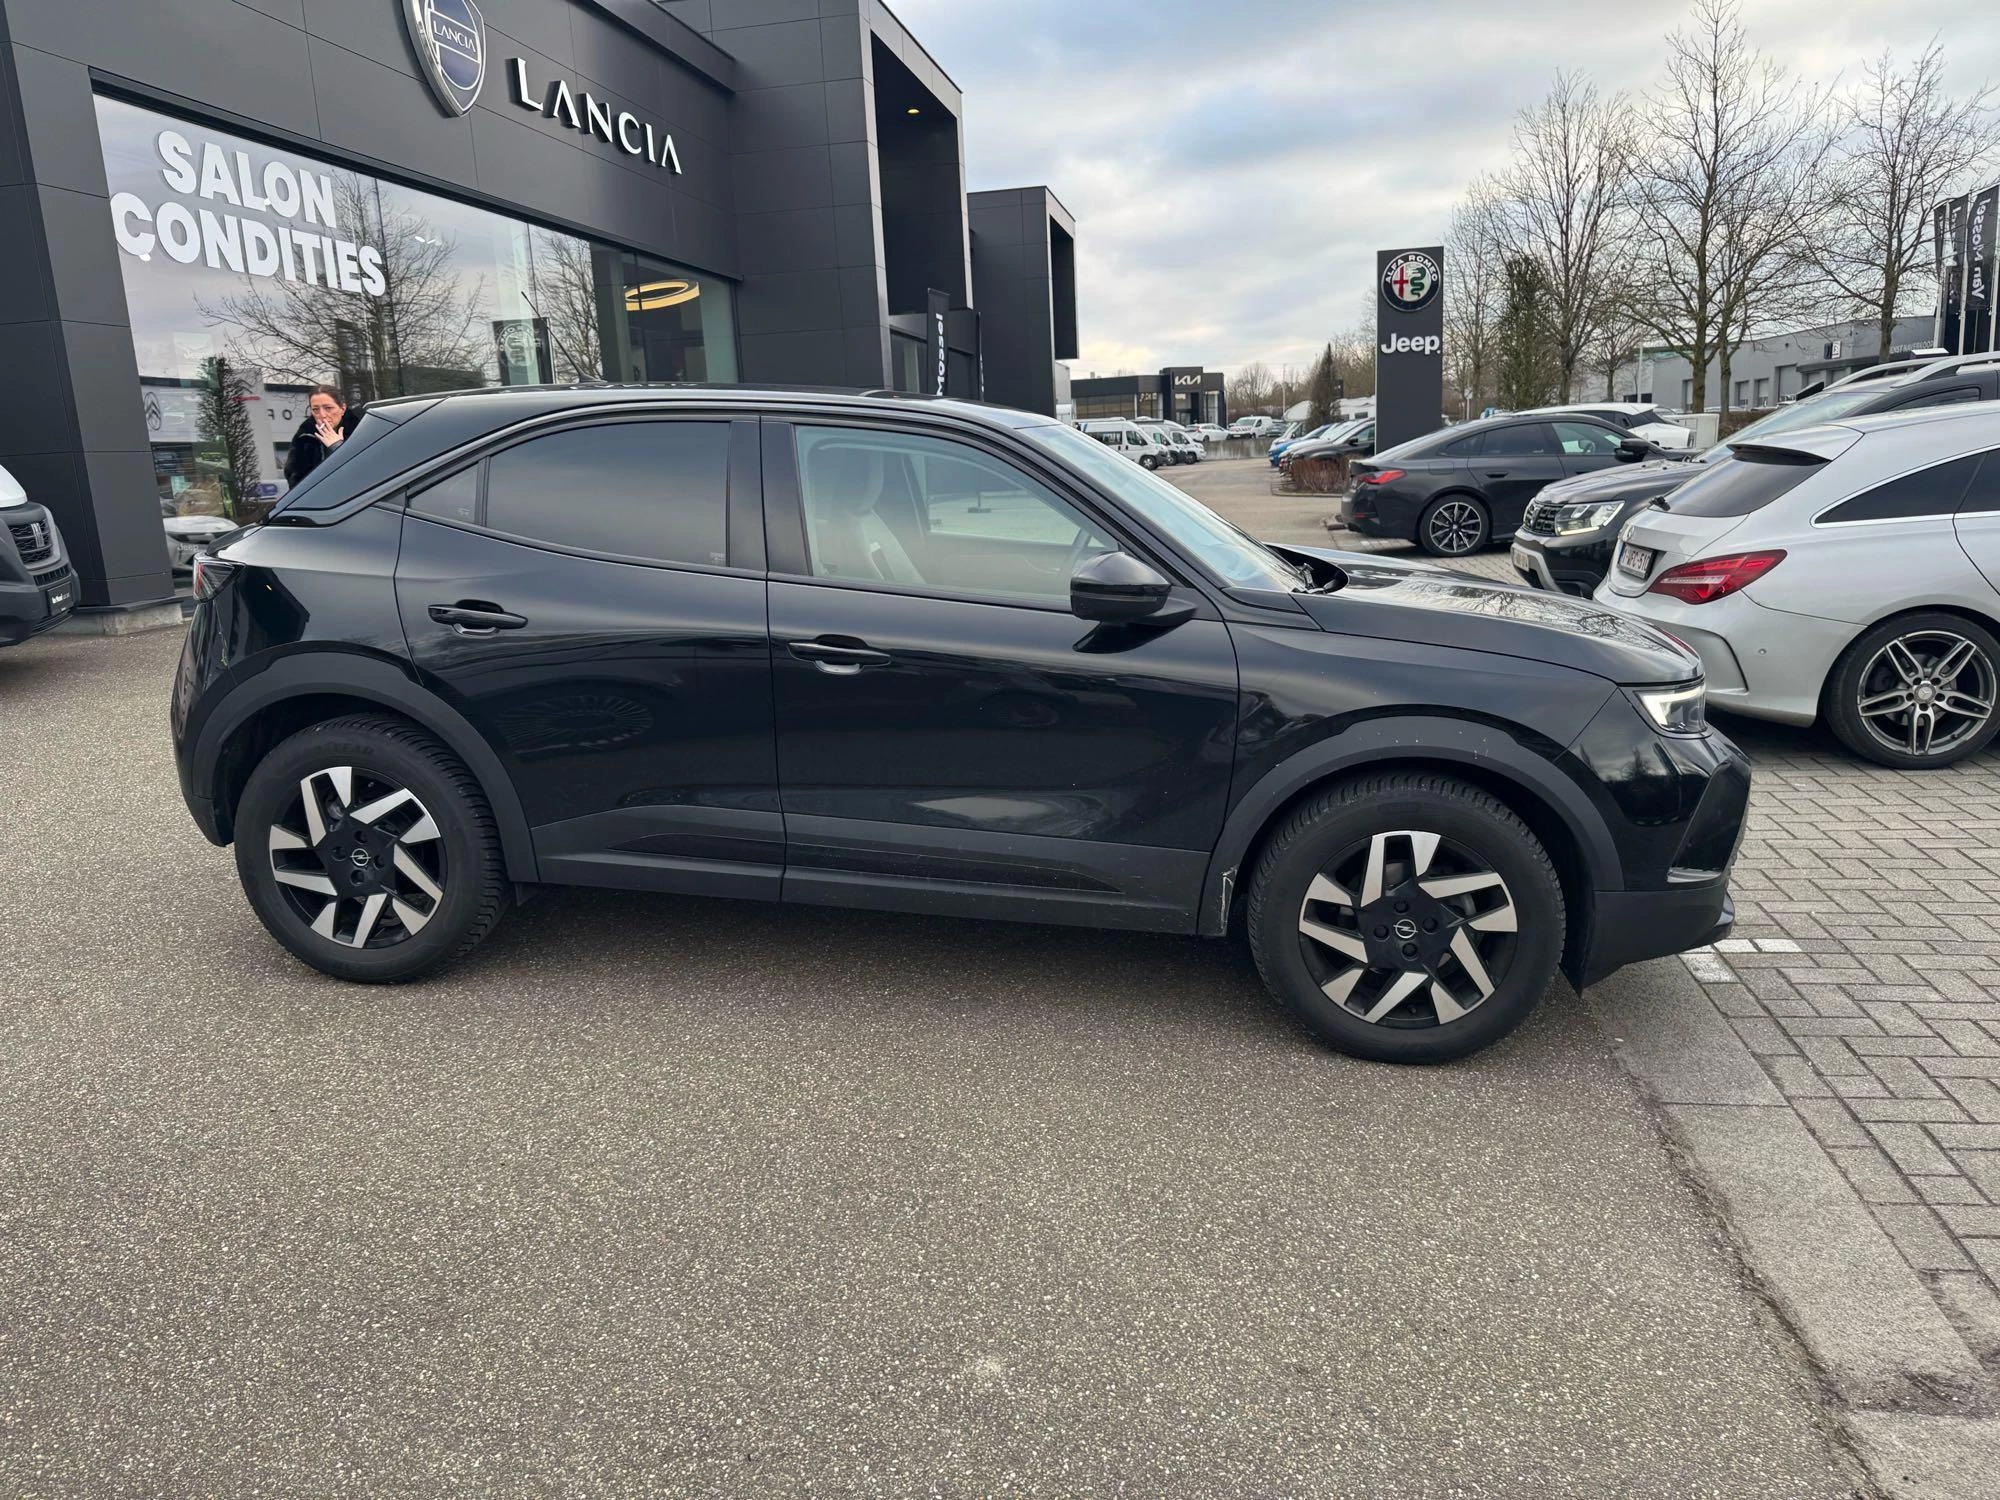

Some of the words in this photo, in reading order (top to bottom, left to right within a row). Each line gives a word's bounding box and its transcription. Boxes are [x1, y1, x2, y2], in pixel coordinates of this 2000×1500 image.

[433, 20, 477, 53] LANCIA
[515, 57, 683, 175] LANCIA
[158, 130, 337, 228] SALON
[110, 191, 386, 297] CONDITIES
[1384, 259, 1405, 283] ALFA
[1408, 254, 1438, 282] ROMEO
[1174, 374, 1202, 386] KIA
